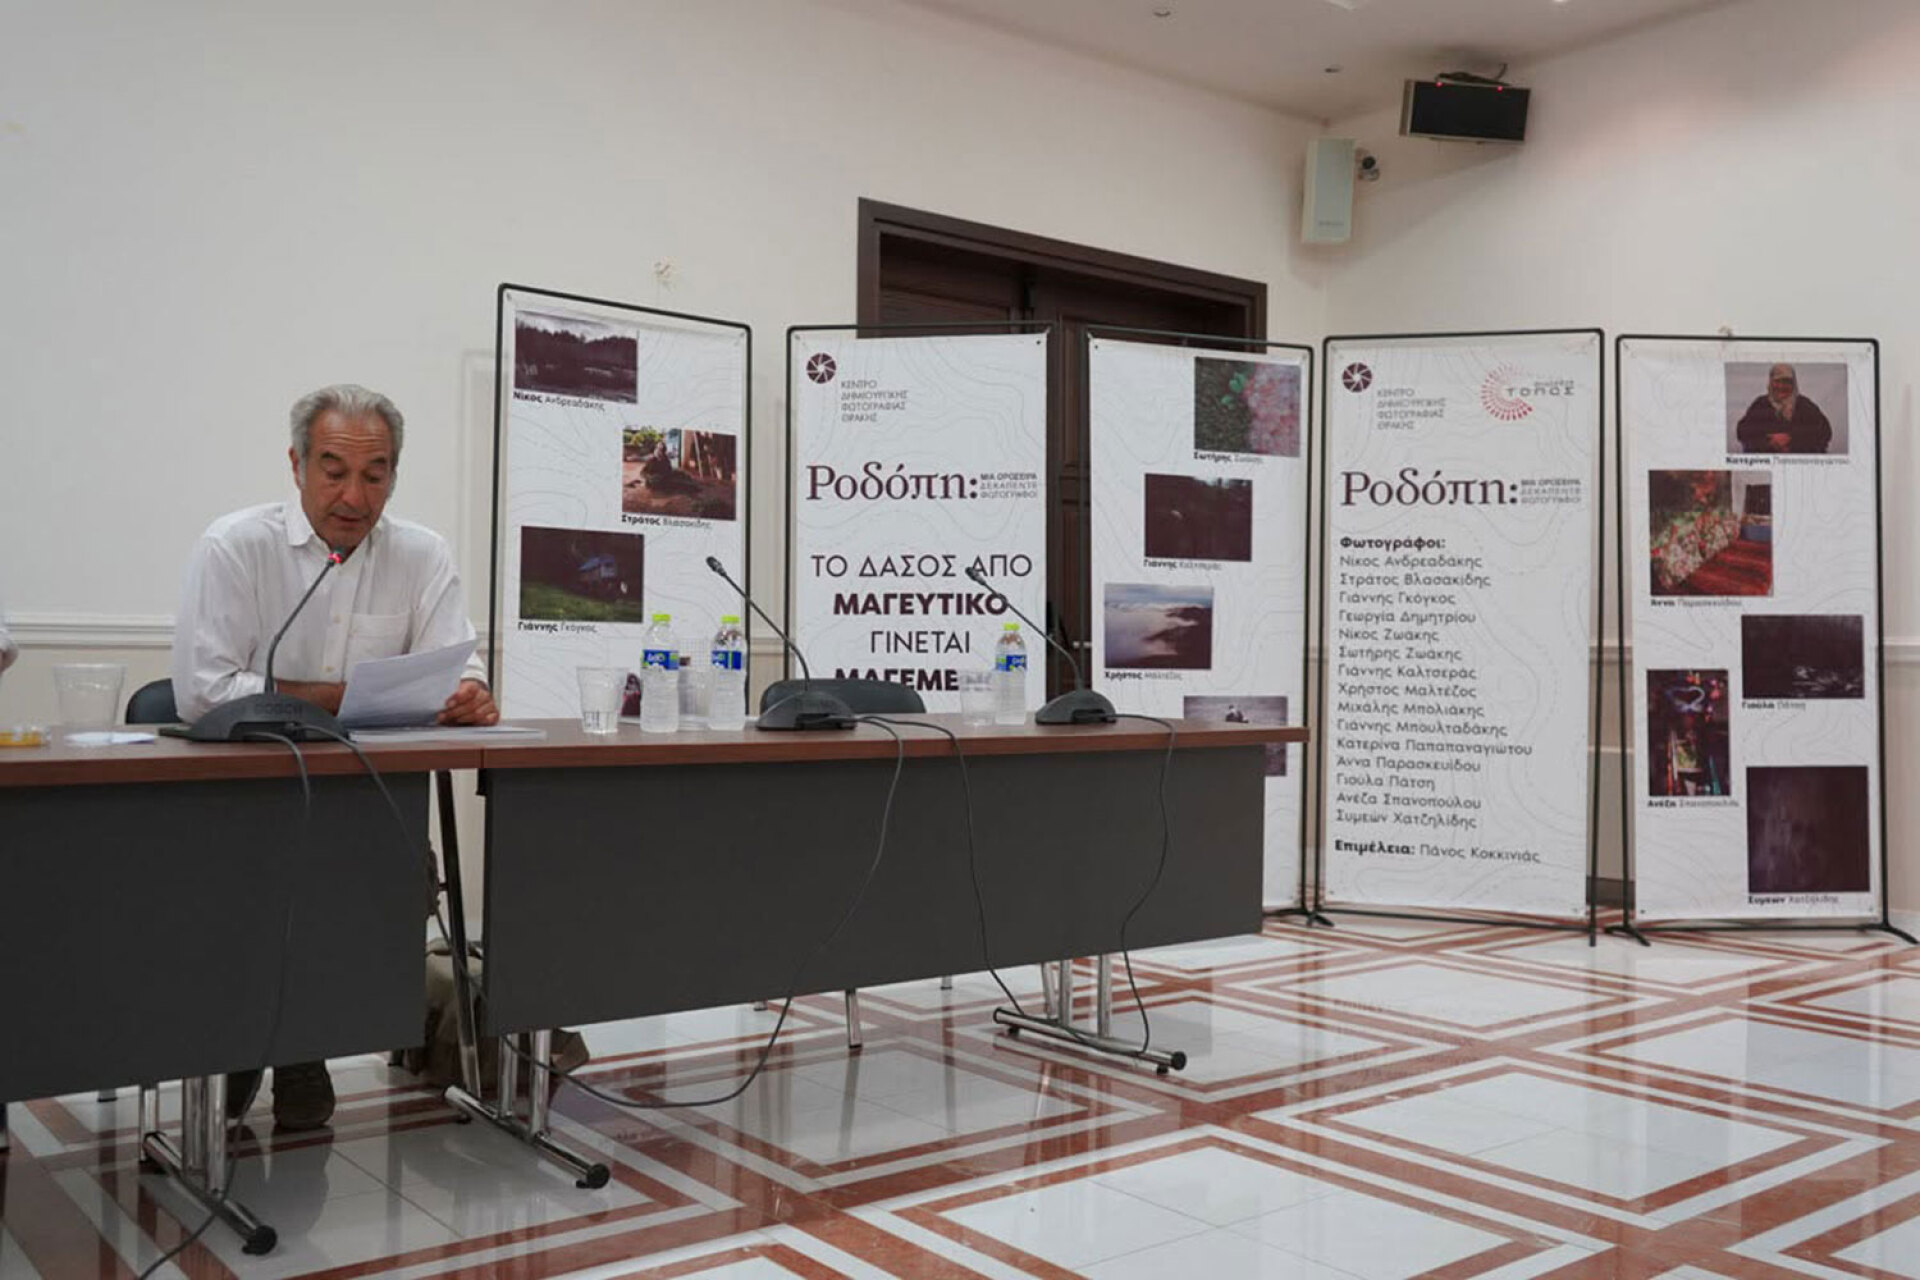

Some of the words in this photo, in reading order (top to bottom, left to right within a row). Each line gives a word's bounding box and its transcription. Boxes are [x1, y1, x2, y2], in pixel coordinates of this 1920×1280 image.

[806, 461, 978, 501] Ροδόπη:
[1340, 467, 1518, 506] Ροδόπη:
[1340, 536, 1446, 552] Φωτογράφοι:
[811, 555, 848, 578] ΤΟ
[858, 554, 957, 577] ΔΑΣΟΣ
[971, 554, 1032, 577] ΑΠΟ
[833, 593, 1009, 616] ΜΑΓΕΥΤΙΚΟ
[870, 631, 970, 654] ΓΙΝΕΤΑΙ
[1335, 839, 1416, 856] Επιμέλεια:
[1420, 844, 1466, 859] Πάνος
[1471, 846, 1541, 863] Κοκκινιάς
